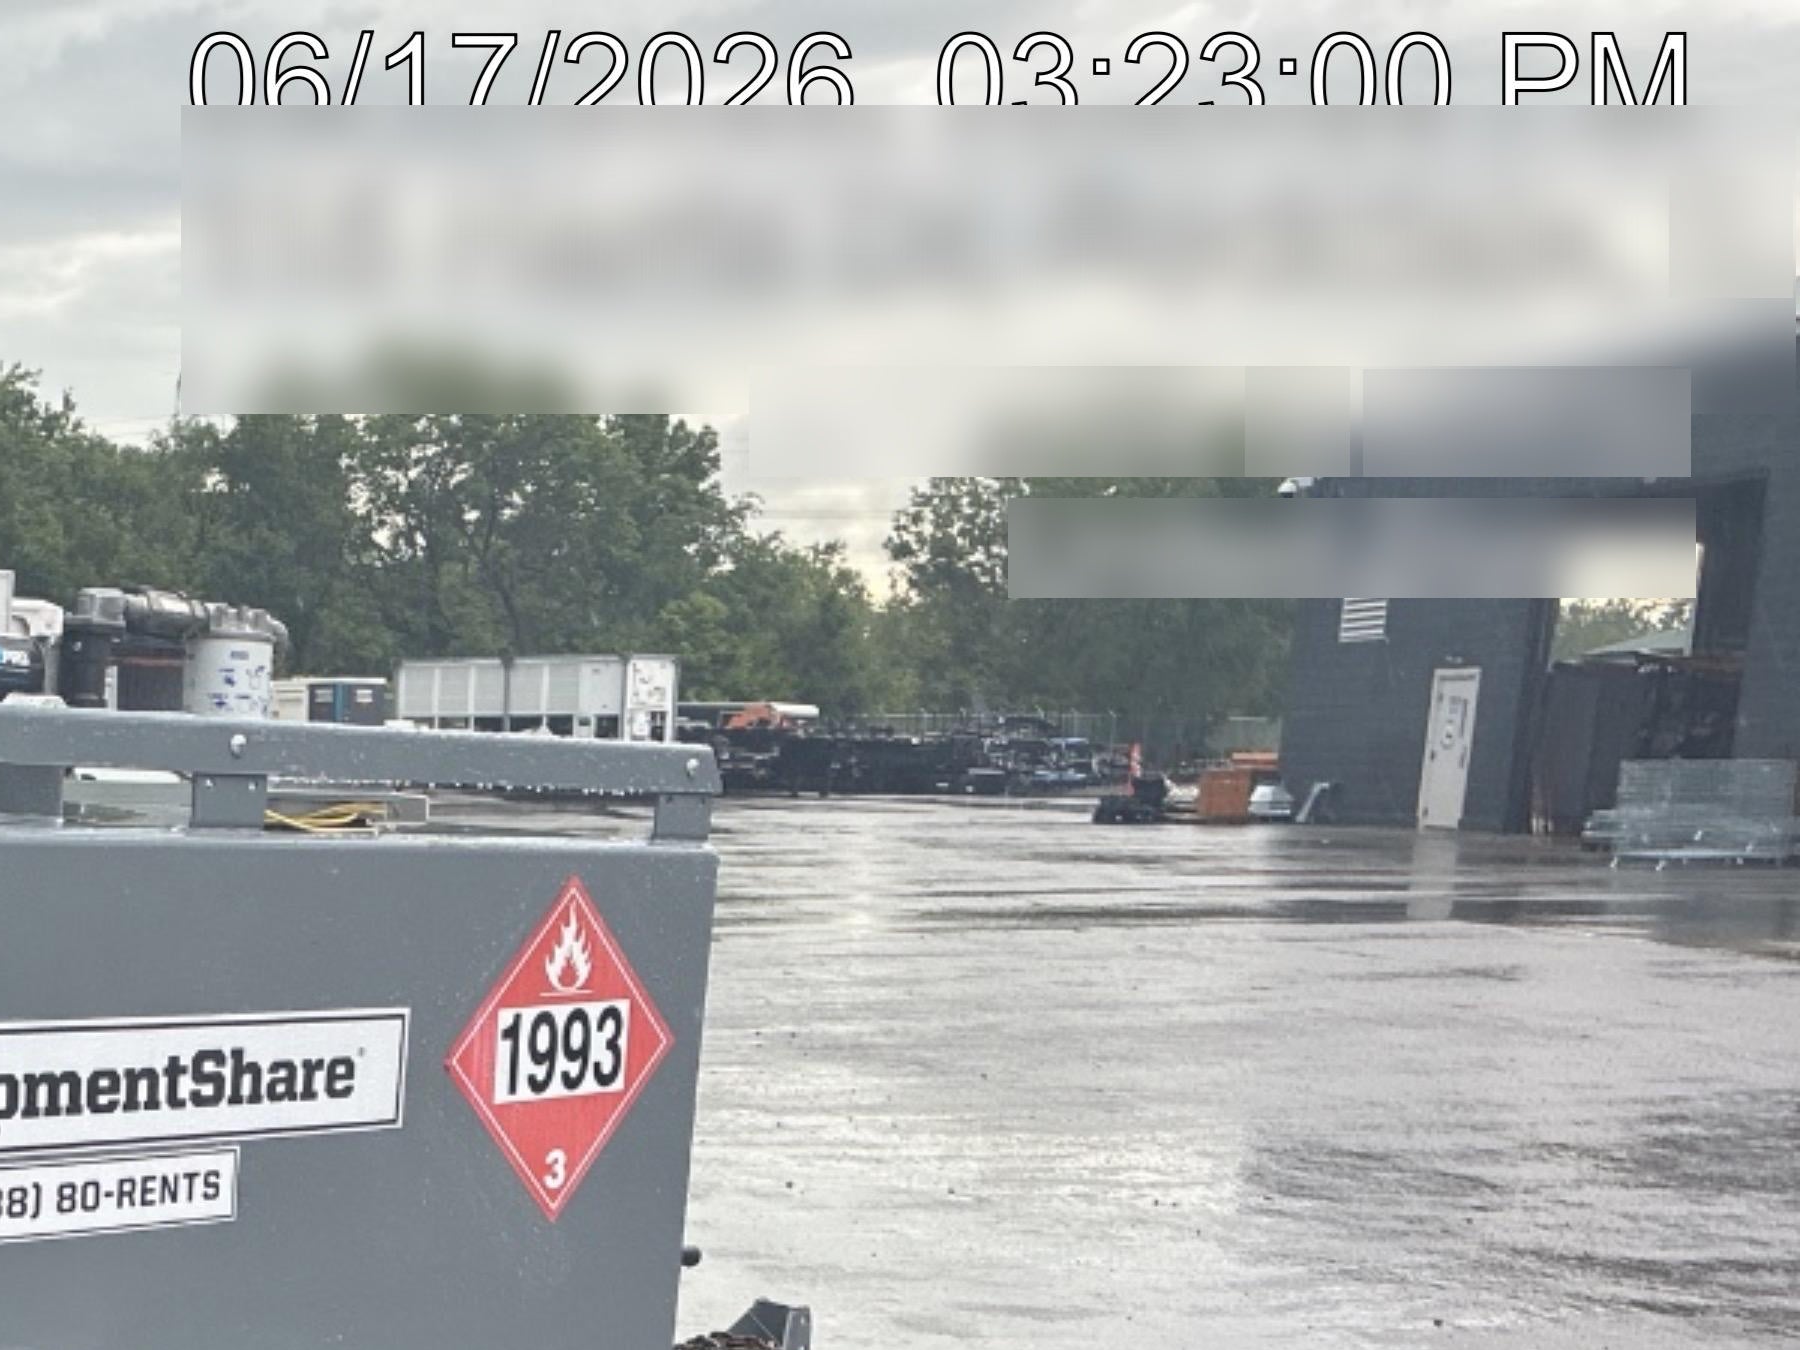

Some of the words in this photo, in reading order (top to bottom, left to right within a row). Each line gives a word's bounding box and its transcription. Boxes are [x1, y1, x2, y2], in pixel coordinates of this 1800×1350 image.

[499, 1004, 625, 1096] 1993
[542, 1147, 567, 1190] 3
[56, 1170, 221, 1213] 80-RENTS
